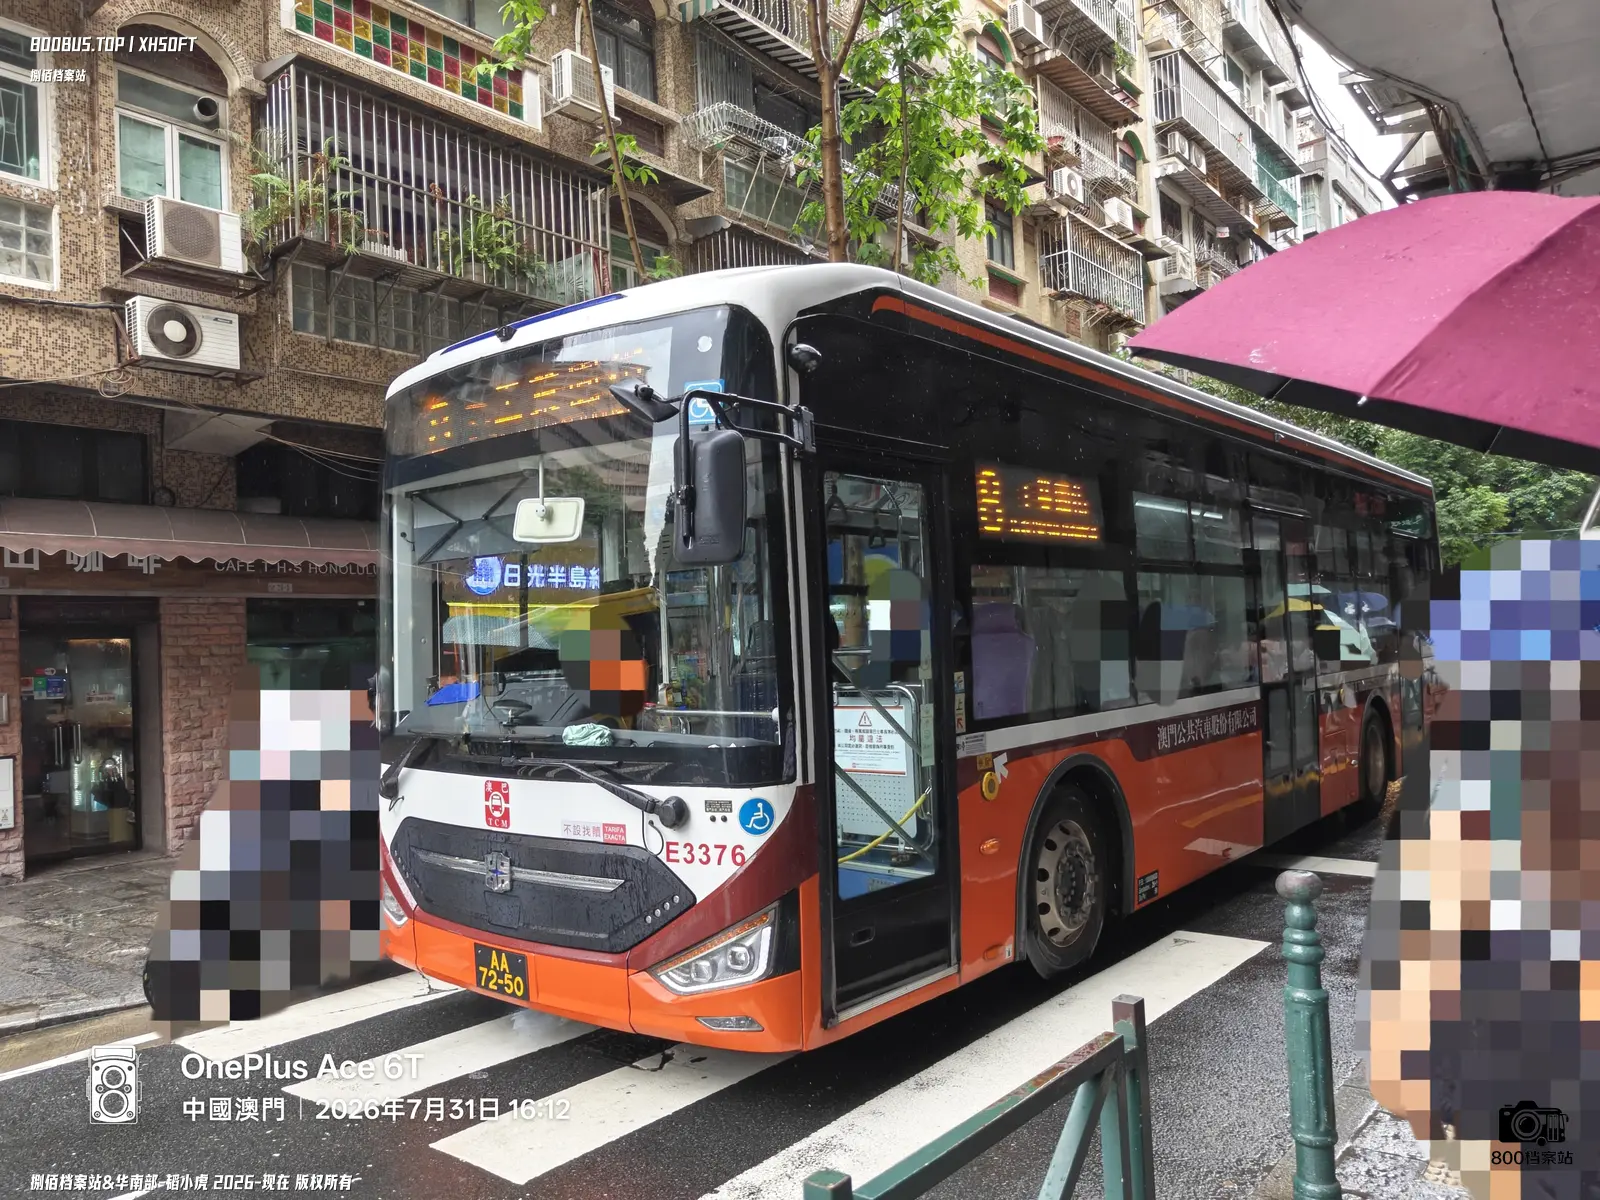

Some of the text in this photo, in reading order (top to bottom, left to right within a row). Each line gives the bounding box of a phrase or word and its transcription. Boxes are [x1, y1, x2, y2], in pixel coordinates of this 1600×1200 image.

[214, 559, 255, 572] CAFE
[1157, 706, 1257, 750] 澳門公共汽車股份有限公司
[487, 818, 508, 828] TCM
[603, 833, 625, 842] EXACTA
[665, 841, 746, 867] E3376
[490, 950, 510, 974] AA
[478, 966, 524, 997] 72-50
